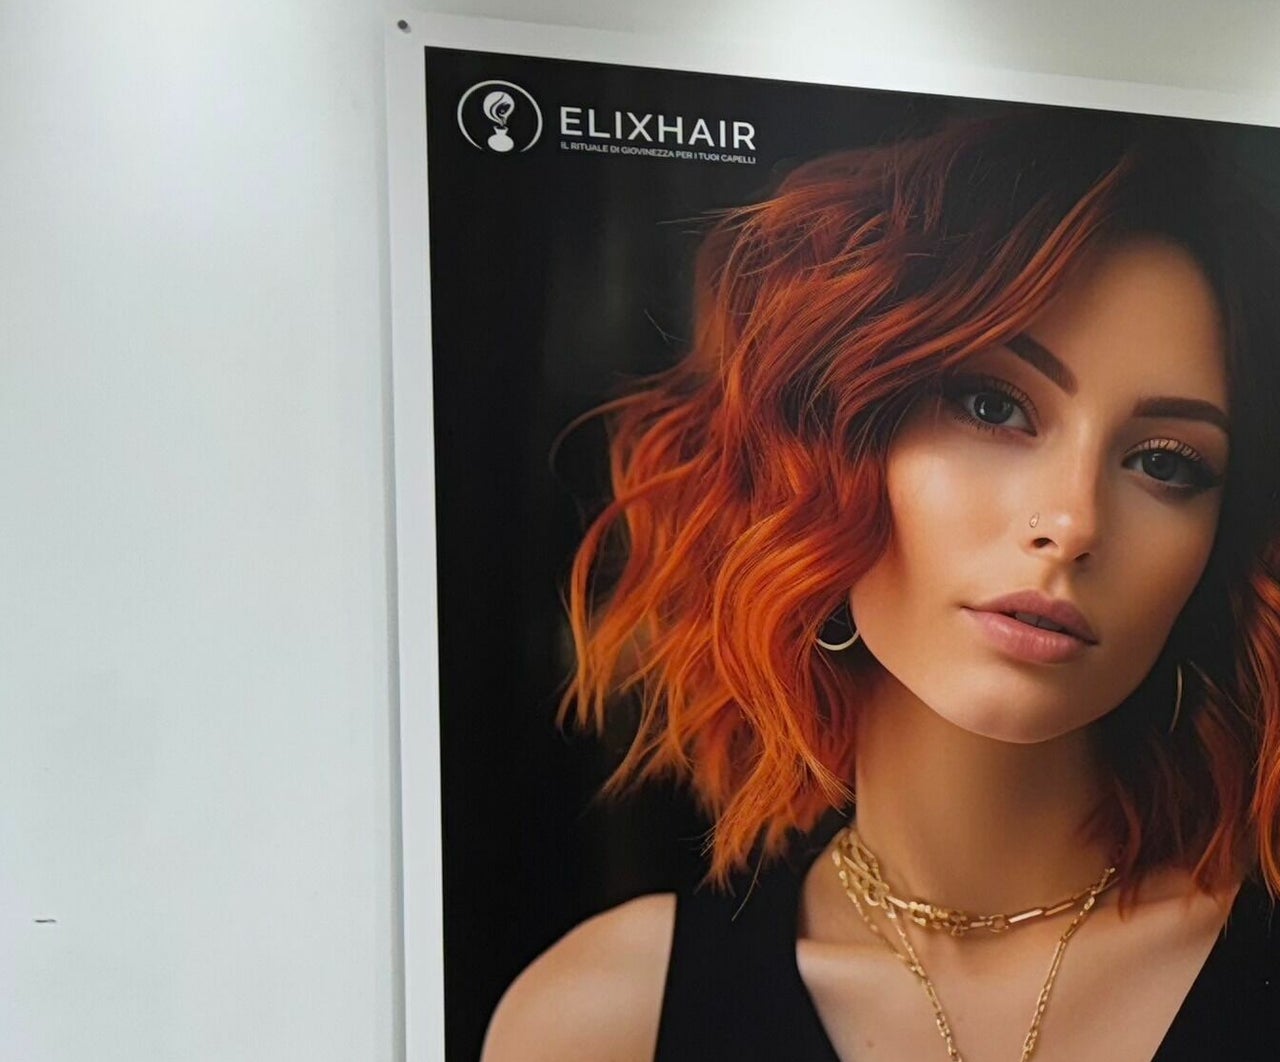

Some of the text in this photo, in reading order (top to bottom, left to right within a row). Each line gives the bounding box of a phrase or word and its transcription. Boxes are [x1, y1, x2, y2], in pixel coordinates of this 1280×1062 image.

[560, 106, 756, 150] ELIXHAIR
[570, 142, 609, 153] RITUALE
[609, 145, 620, 153] DI
[620, 146, 675, 158] GIOVINEZZA
[675, 151, 693, 159] PER
[698, 152, 720, 161] TUOI
[720, 154, 756, 164] CAPELLI
